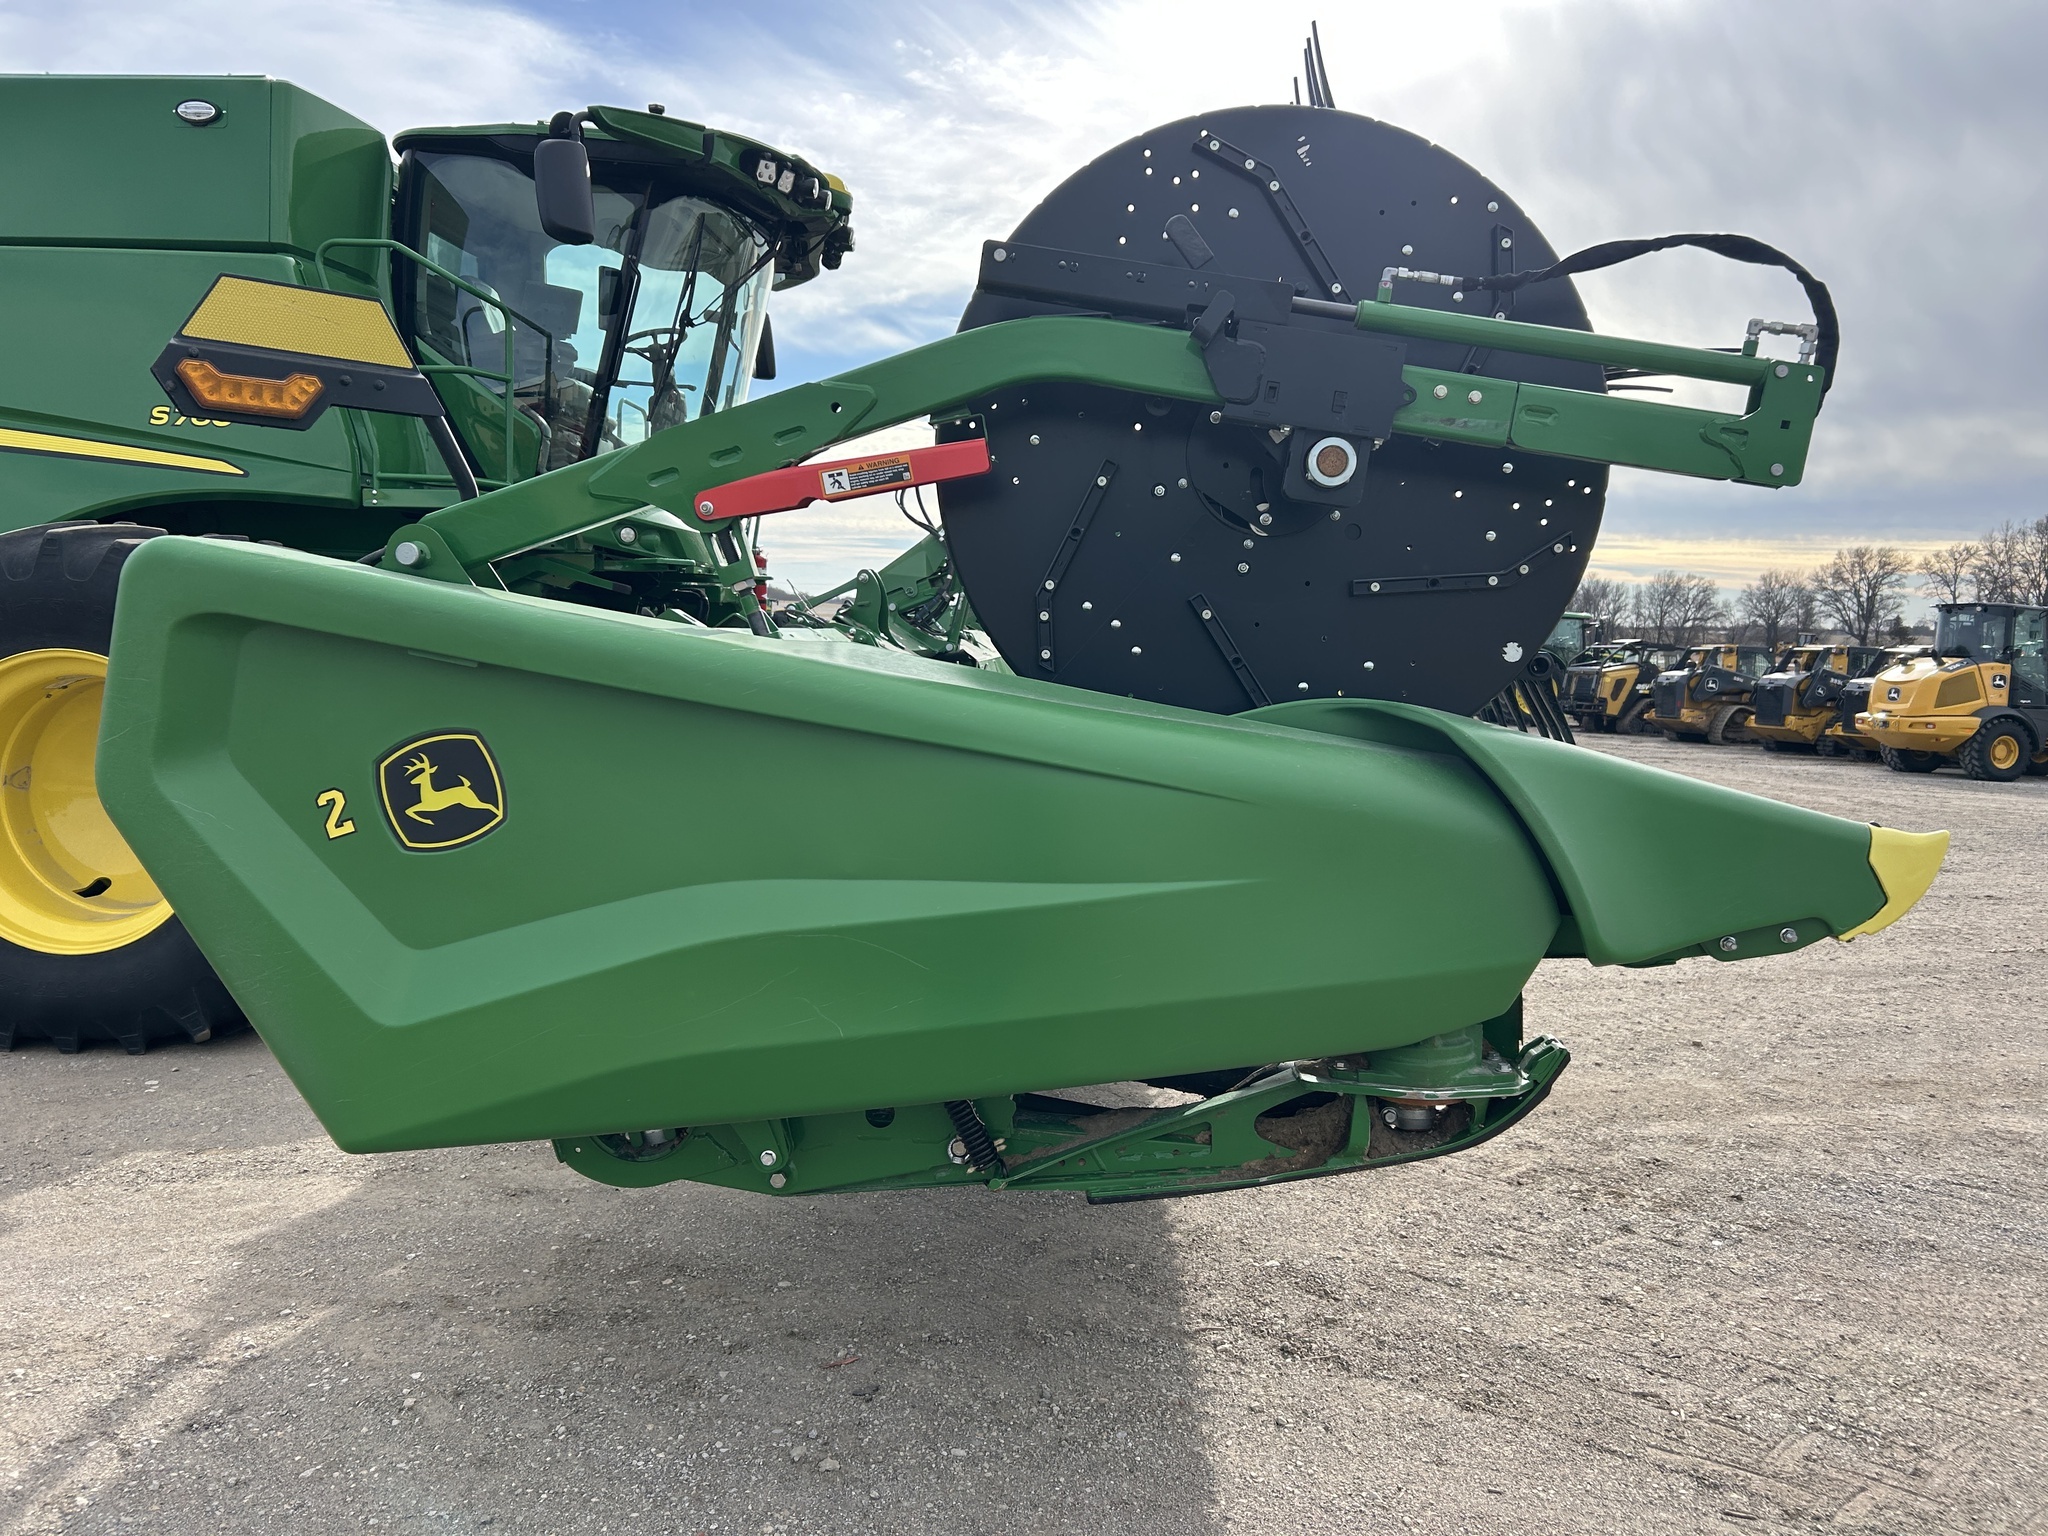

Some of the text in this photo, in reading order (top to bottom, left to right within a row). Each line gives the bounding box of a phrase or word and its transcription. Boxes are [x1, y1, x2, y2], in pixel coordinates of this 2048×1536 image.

[1136, 270, 1146, 283] 2
[865, 457, 900, 469] WARNING
[316, 787, 357, 841] 2
